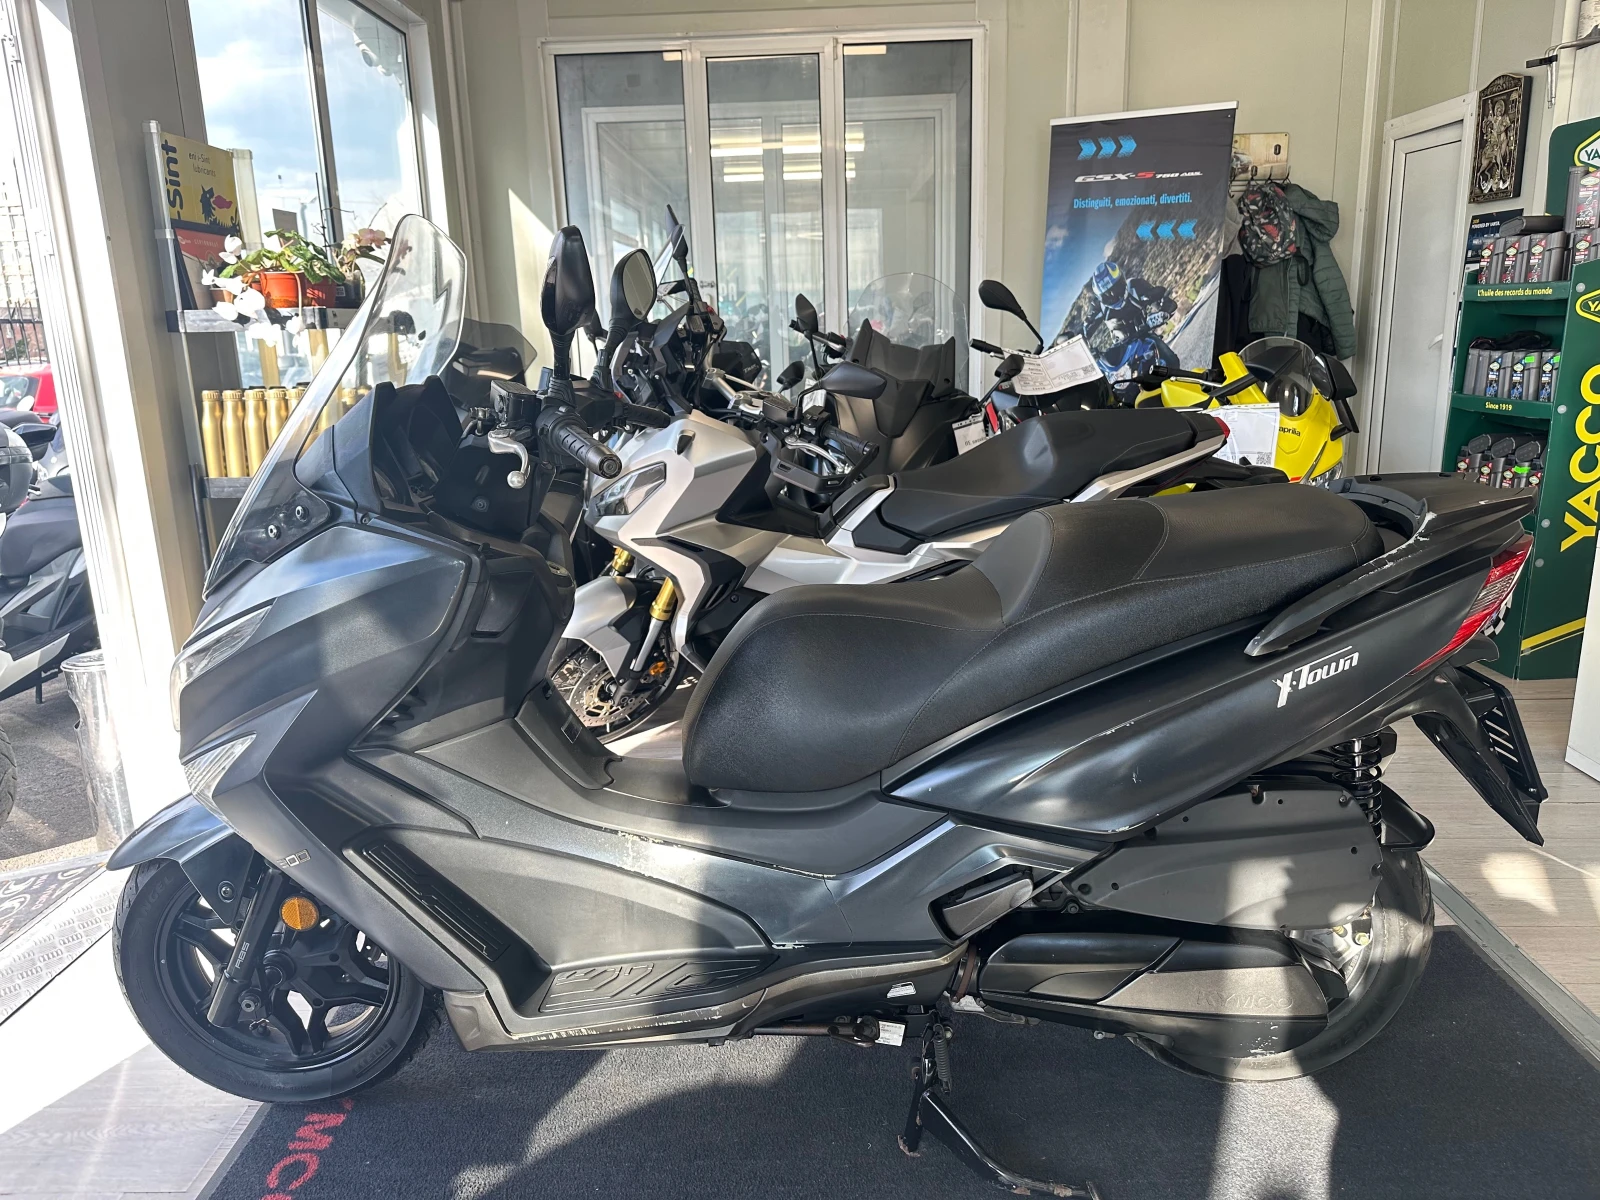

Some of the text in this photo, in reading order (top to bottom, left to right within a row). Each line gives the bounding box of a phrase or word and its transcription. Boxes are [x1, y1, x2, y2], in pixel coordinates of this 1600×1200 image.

[1075, 171, 1155, 183] GSX-S
[1073, 192, 1193, 210] Distinguiti, emozionati, divertiti.
[1477, 286, 1553, 297] L'huile des records du monde
[1485, 401, 1513, 411] Since 1919
[1279, 426, 1301, 437] aprilia
